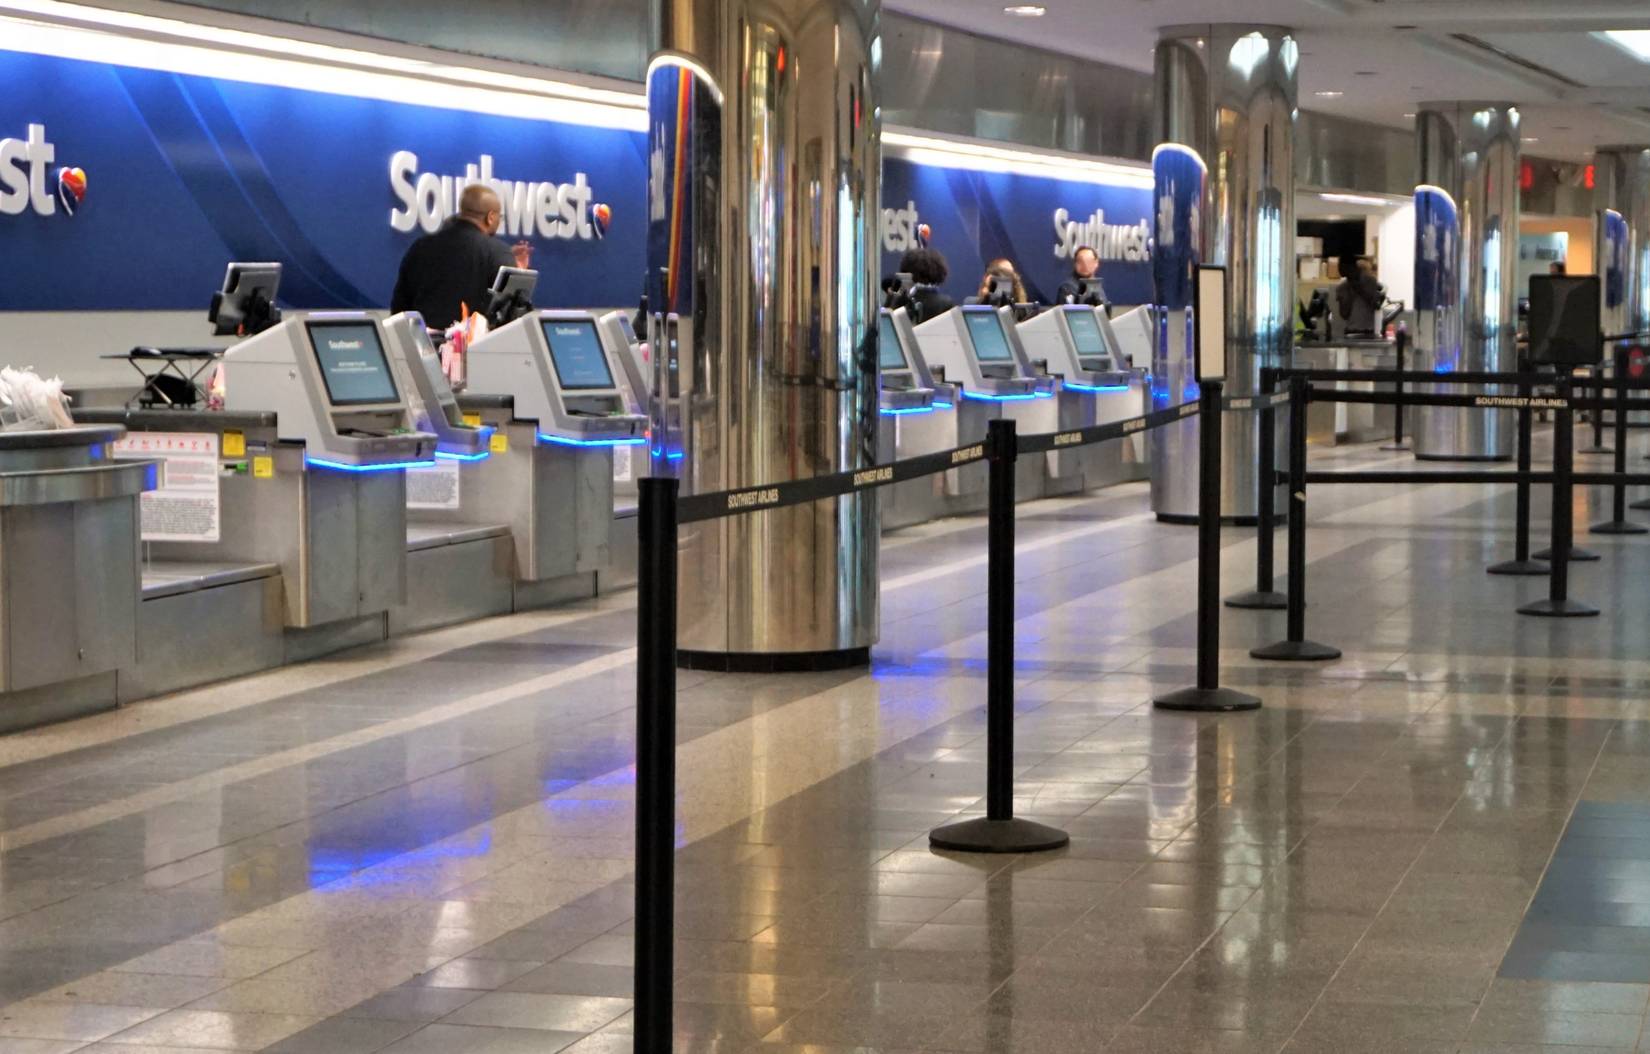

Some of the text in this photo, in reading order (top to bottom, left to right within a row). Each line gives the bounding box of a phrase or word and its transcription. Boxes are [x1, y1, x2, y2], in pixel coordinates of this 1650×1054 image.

[880, 200, 918, 251] est
[1054, 207, 1149, 262] Southwest
[1475, 396, 1568, 407] SOUTHWEST AIRLINES
[728, 491, 758, 509] SOUTHWEST
